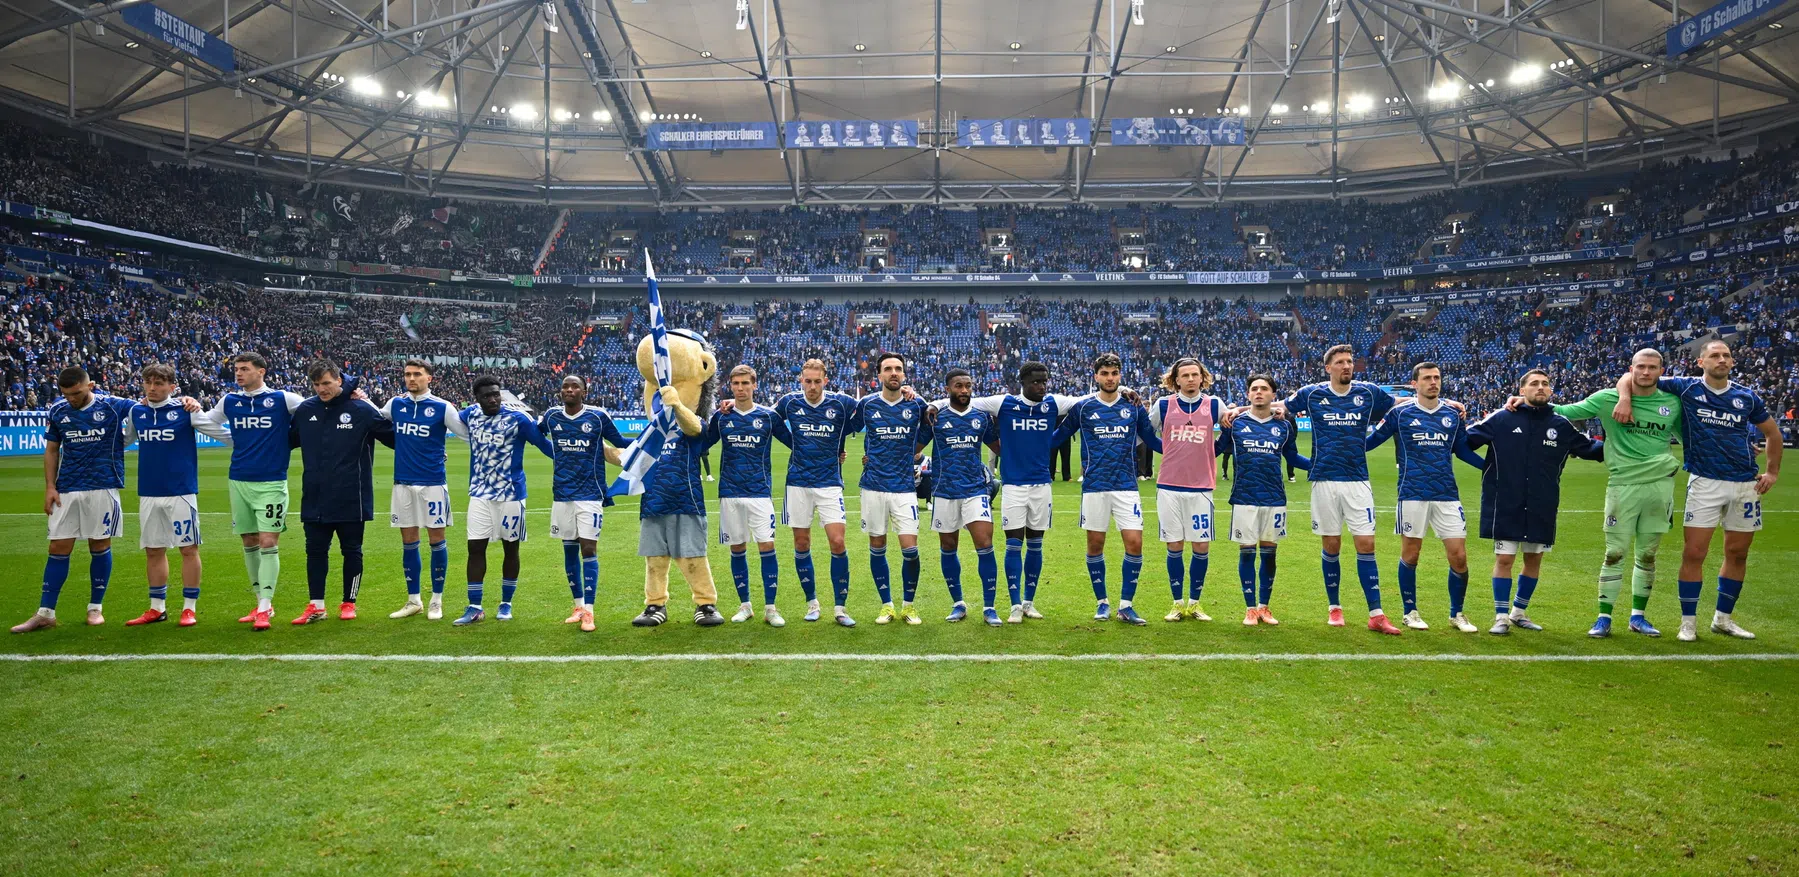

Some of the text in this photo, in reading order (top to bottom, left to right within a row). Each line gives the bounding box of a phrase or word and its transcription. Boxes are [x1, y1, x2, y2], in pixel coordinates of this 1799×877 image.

[1700, 15, 1712, 36] FC
[1714, 0, 1753, 29] Schalke
[154, 8, 206, 48] #STEHTAUF
[163, 31, 198, 56] für Vielfalt
[660, 128, 764, 142] SCHALKER EHRENSPIELFÜHRER
[1095, 273, 1125, 281] VELTINS
[1383, 266, 1413, 277] VELTINS
[532, 276, 562, 284] VELTINS
[834, 275, 864, 283] VELTINS
[1188, 271, 1258, 284] MIT GOTT AUF SCHALKE
[1323, 412, 1362, 421] SUN
[1696, 408, 1742, 423] SUN
[234, 416, 272, 429] HRS
[799, 423, 835, 432] SUN
[1012, 419, 1048, 431] HRS
[1621, 420, 1666, 431] SUN
[1701, 418, 1735, 428] MINIMEAL
[65, 427, 106, 439] SUN
[138, 429, 175, 441] HRS
[396, 421, 430, 438] HRS
[875, 426, 910, 435] SUN
[1094, 425, 1129, 434] SUN
[1626, 429, 1660, 437] MINIMEAL
[727, 434, 761, 443] SUN
[945, 435, 978, 444] SUN
[1099, 432, 1125, 440] MINIMEAL
[1170, 430, 1205, 444] HRS
[1412, 432, 1449, 441] SUN
[558, 439, 590, 447] SUN
[1243, 439, 1279, 449] SUN
[1543, 439, 1557, 448] HRS
[1248, 447, 1275, 455] MINIMEAL
[265, 504, 284, 519] 32
[428, 501, 442, 516] 21
[1743, 501, 1761, 519] 25
[102, 512, 111, 526] 4
[502, 515, 519, 530] 47
[1192, 513, 1209, 530] 35
[173, 519, 192, 536] 37
